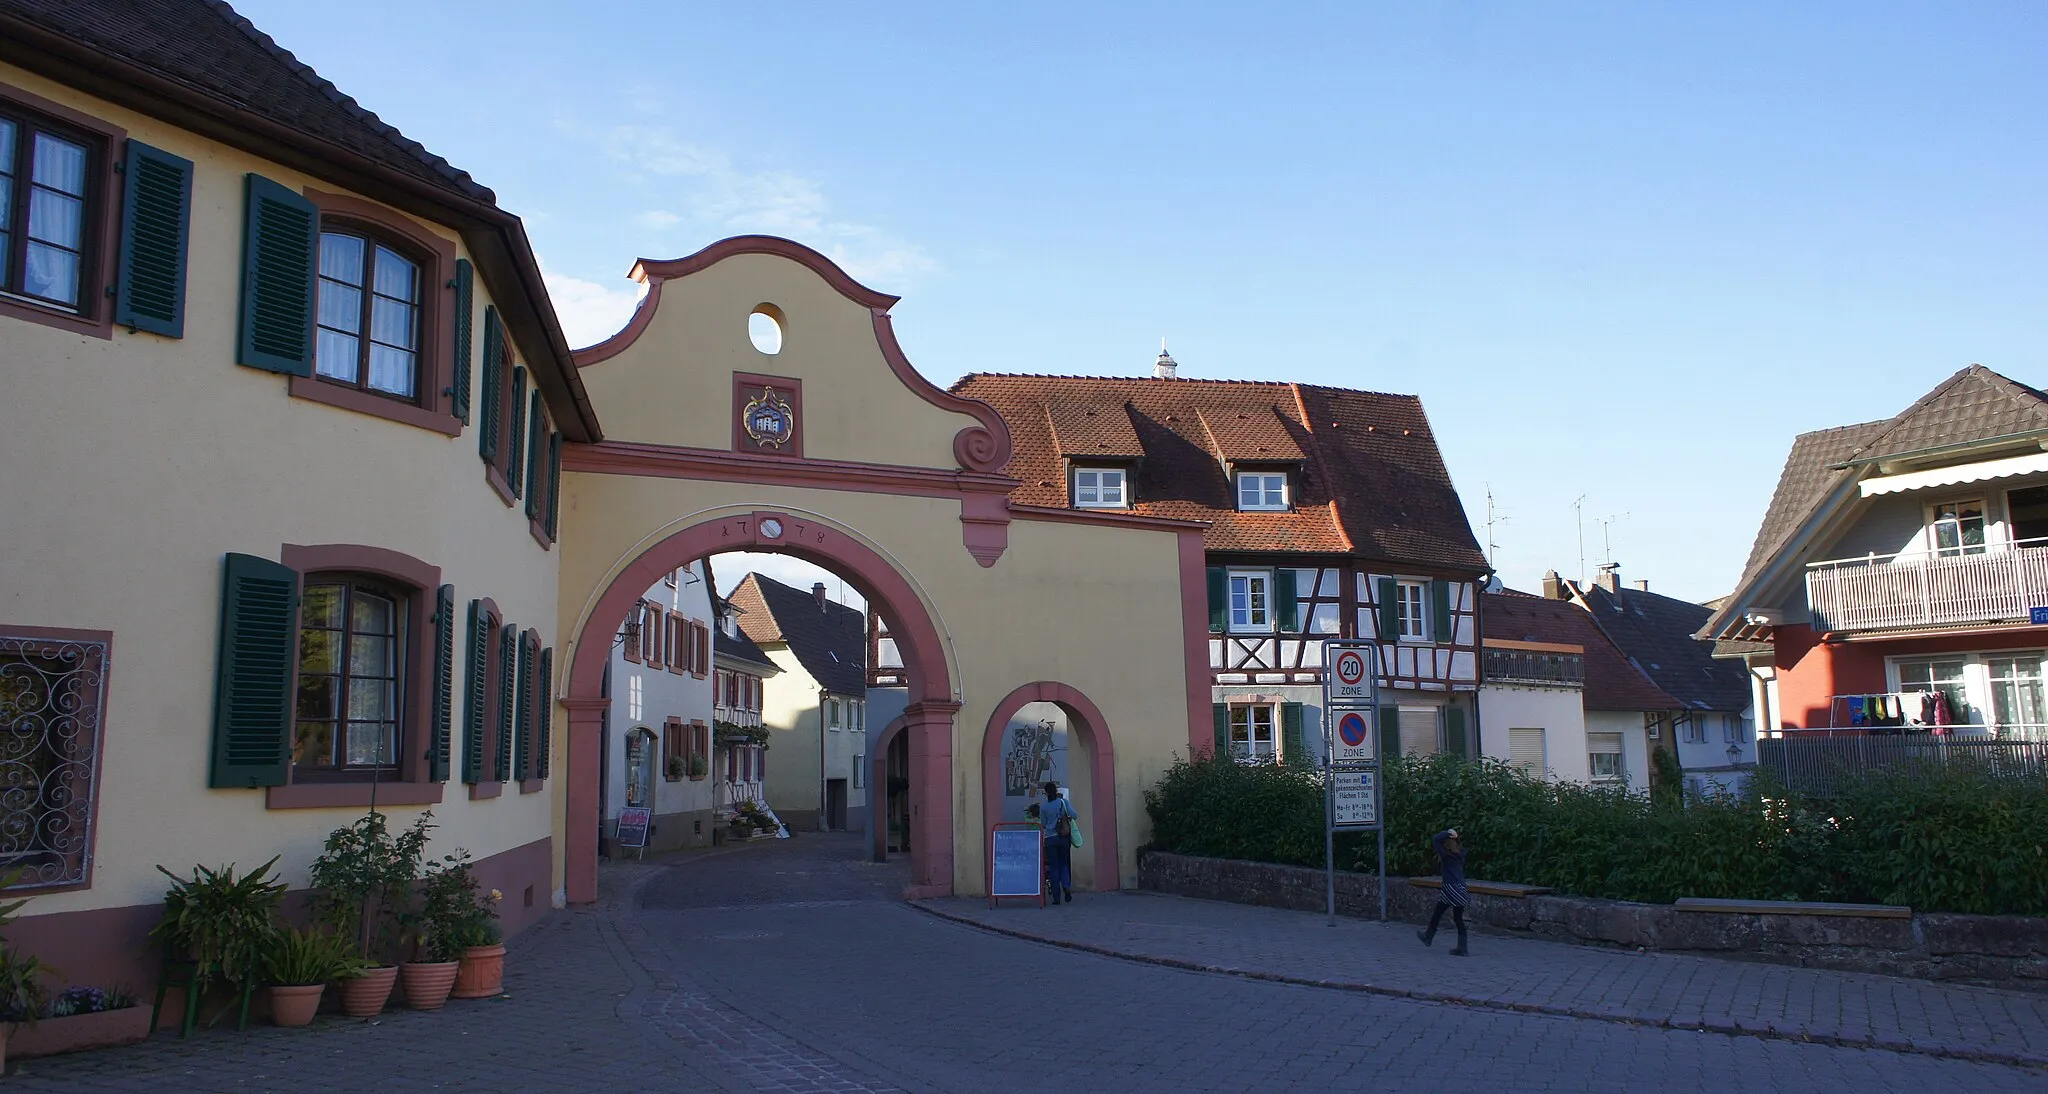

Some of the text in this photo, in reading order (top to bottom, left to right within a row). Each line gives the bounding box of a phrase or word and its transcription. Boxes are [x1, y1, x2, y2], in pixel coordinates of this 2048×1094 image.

[1343, 660, 1359, 676] 20
[1341, 686, 1362, 696] ZONE
[1343, 748, 1364, 757] ZONE
